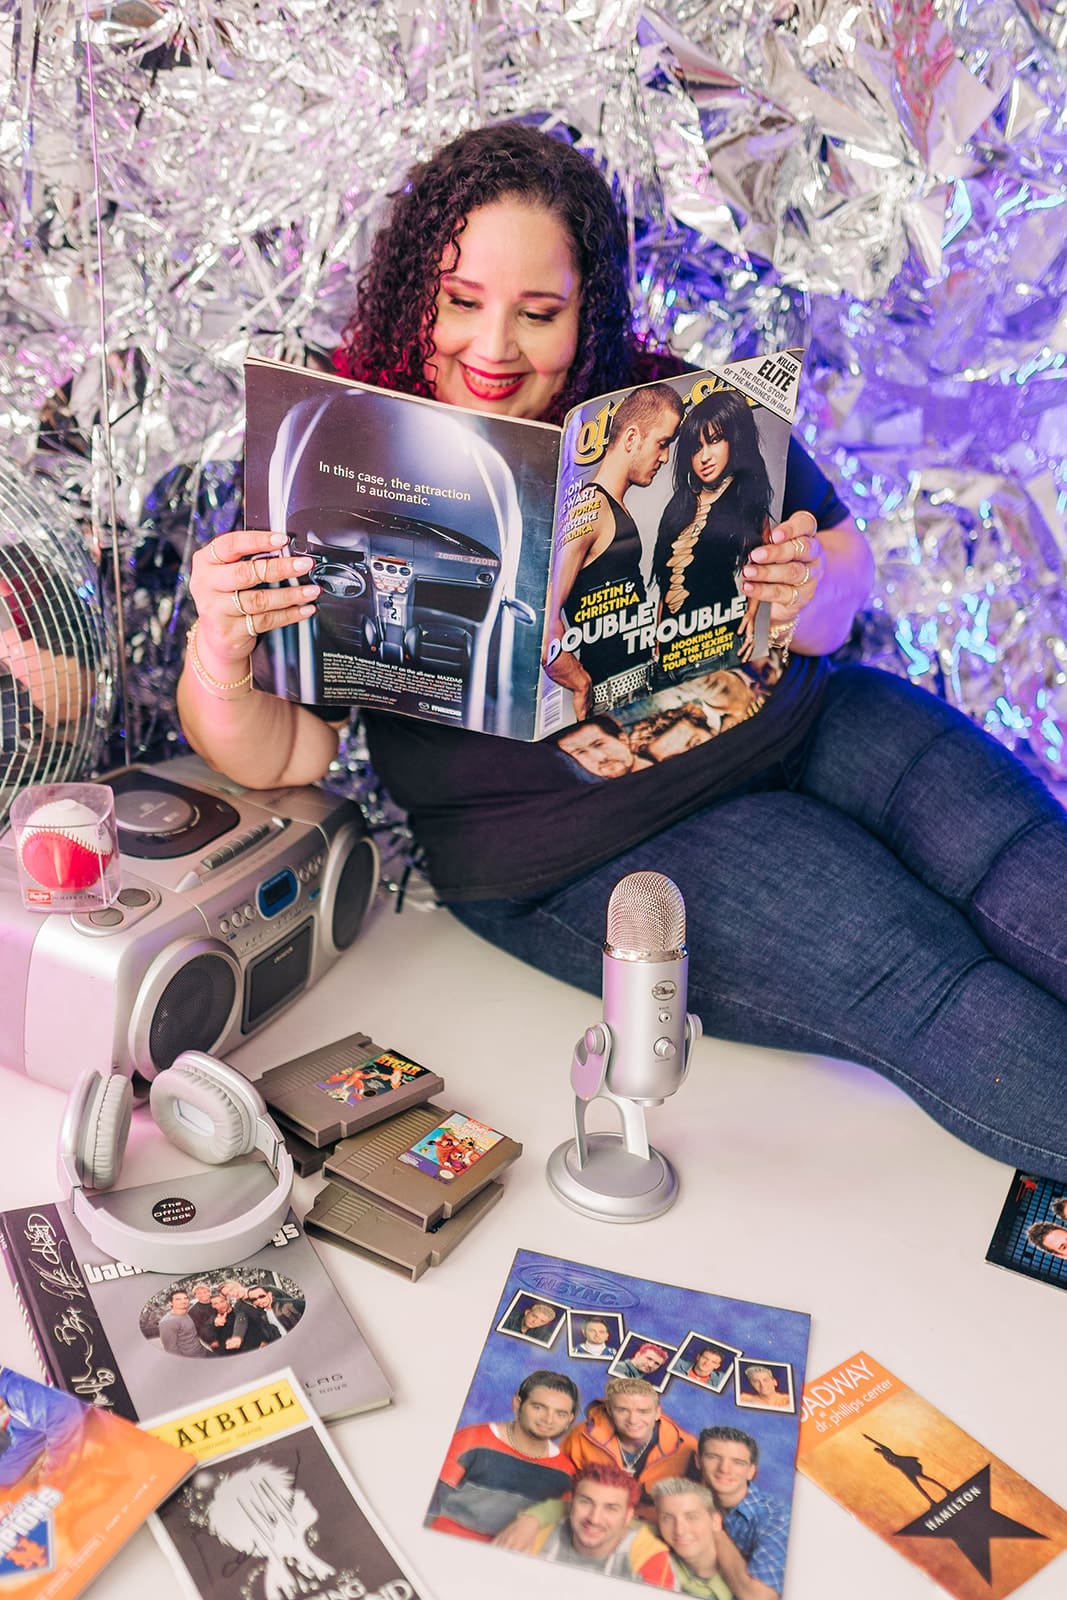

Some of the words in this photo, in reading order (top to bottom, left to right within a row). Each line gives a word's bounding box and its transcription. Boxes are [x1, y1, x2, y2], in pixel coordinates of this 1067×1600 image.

[757, 359, 796, 393] ELITE
[776, 356, 798, 375] KILLER
[723, 368, 734, 376] OF
[732, 372, 745, 385] THE
[745, 380, 770, 402] MARINES
[770, 397, 778, 407] IN
[777, 403, 792, 416] IRAQ
[740, 367, 752, 380] THE
[751, 376, 768, 391] REAL
[767, 386, 788, 402] STORY
[319, 461, 330, 473] In
[333, 464, 355, 480] this
[358, 472, 388, 488] case,
[391, 477, 411, 491] the
[414, 483, 471, 501] attraction
[356, 482, 366, 494] is
[369, 487, 430, 506] automatic.
[574, 592, 640, 623] CHRISTINA
[580, 583, 624, 609] JUSTIN
[624, 581, 635, 593] &
[547, 599, 654, 666] DOUBLE
[622, 595, 747, 655] TROUBLE
[671, 630, 713, 652] HOOKING
[714, 626, 727, 636] UP
[662, 651, 681, 663] FOR
[682, 645, 700, 656] THE
[701, 631, 734, 650] SEXIEST
[662, 660, 687, 672] TOUR
[688, 652, 703, 663] ON
[703, 641, 733, 658] EARTH
[153, 1205, 194, 1218] Official
[160, 1201, 182, 1209] The
[162, 1212, 191, 1223] Book
[800, 1357, 875, 1423] ADWAY
[815, 1419, 832, 1433] dr.
[830, 1397, 865, 1426] phillips
[862, 1379, 893, 1402] center
[176, 1391, 295, 1449] AYBILL
[924, 1485, 982, 1532] HAMILTON
